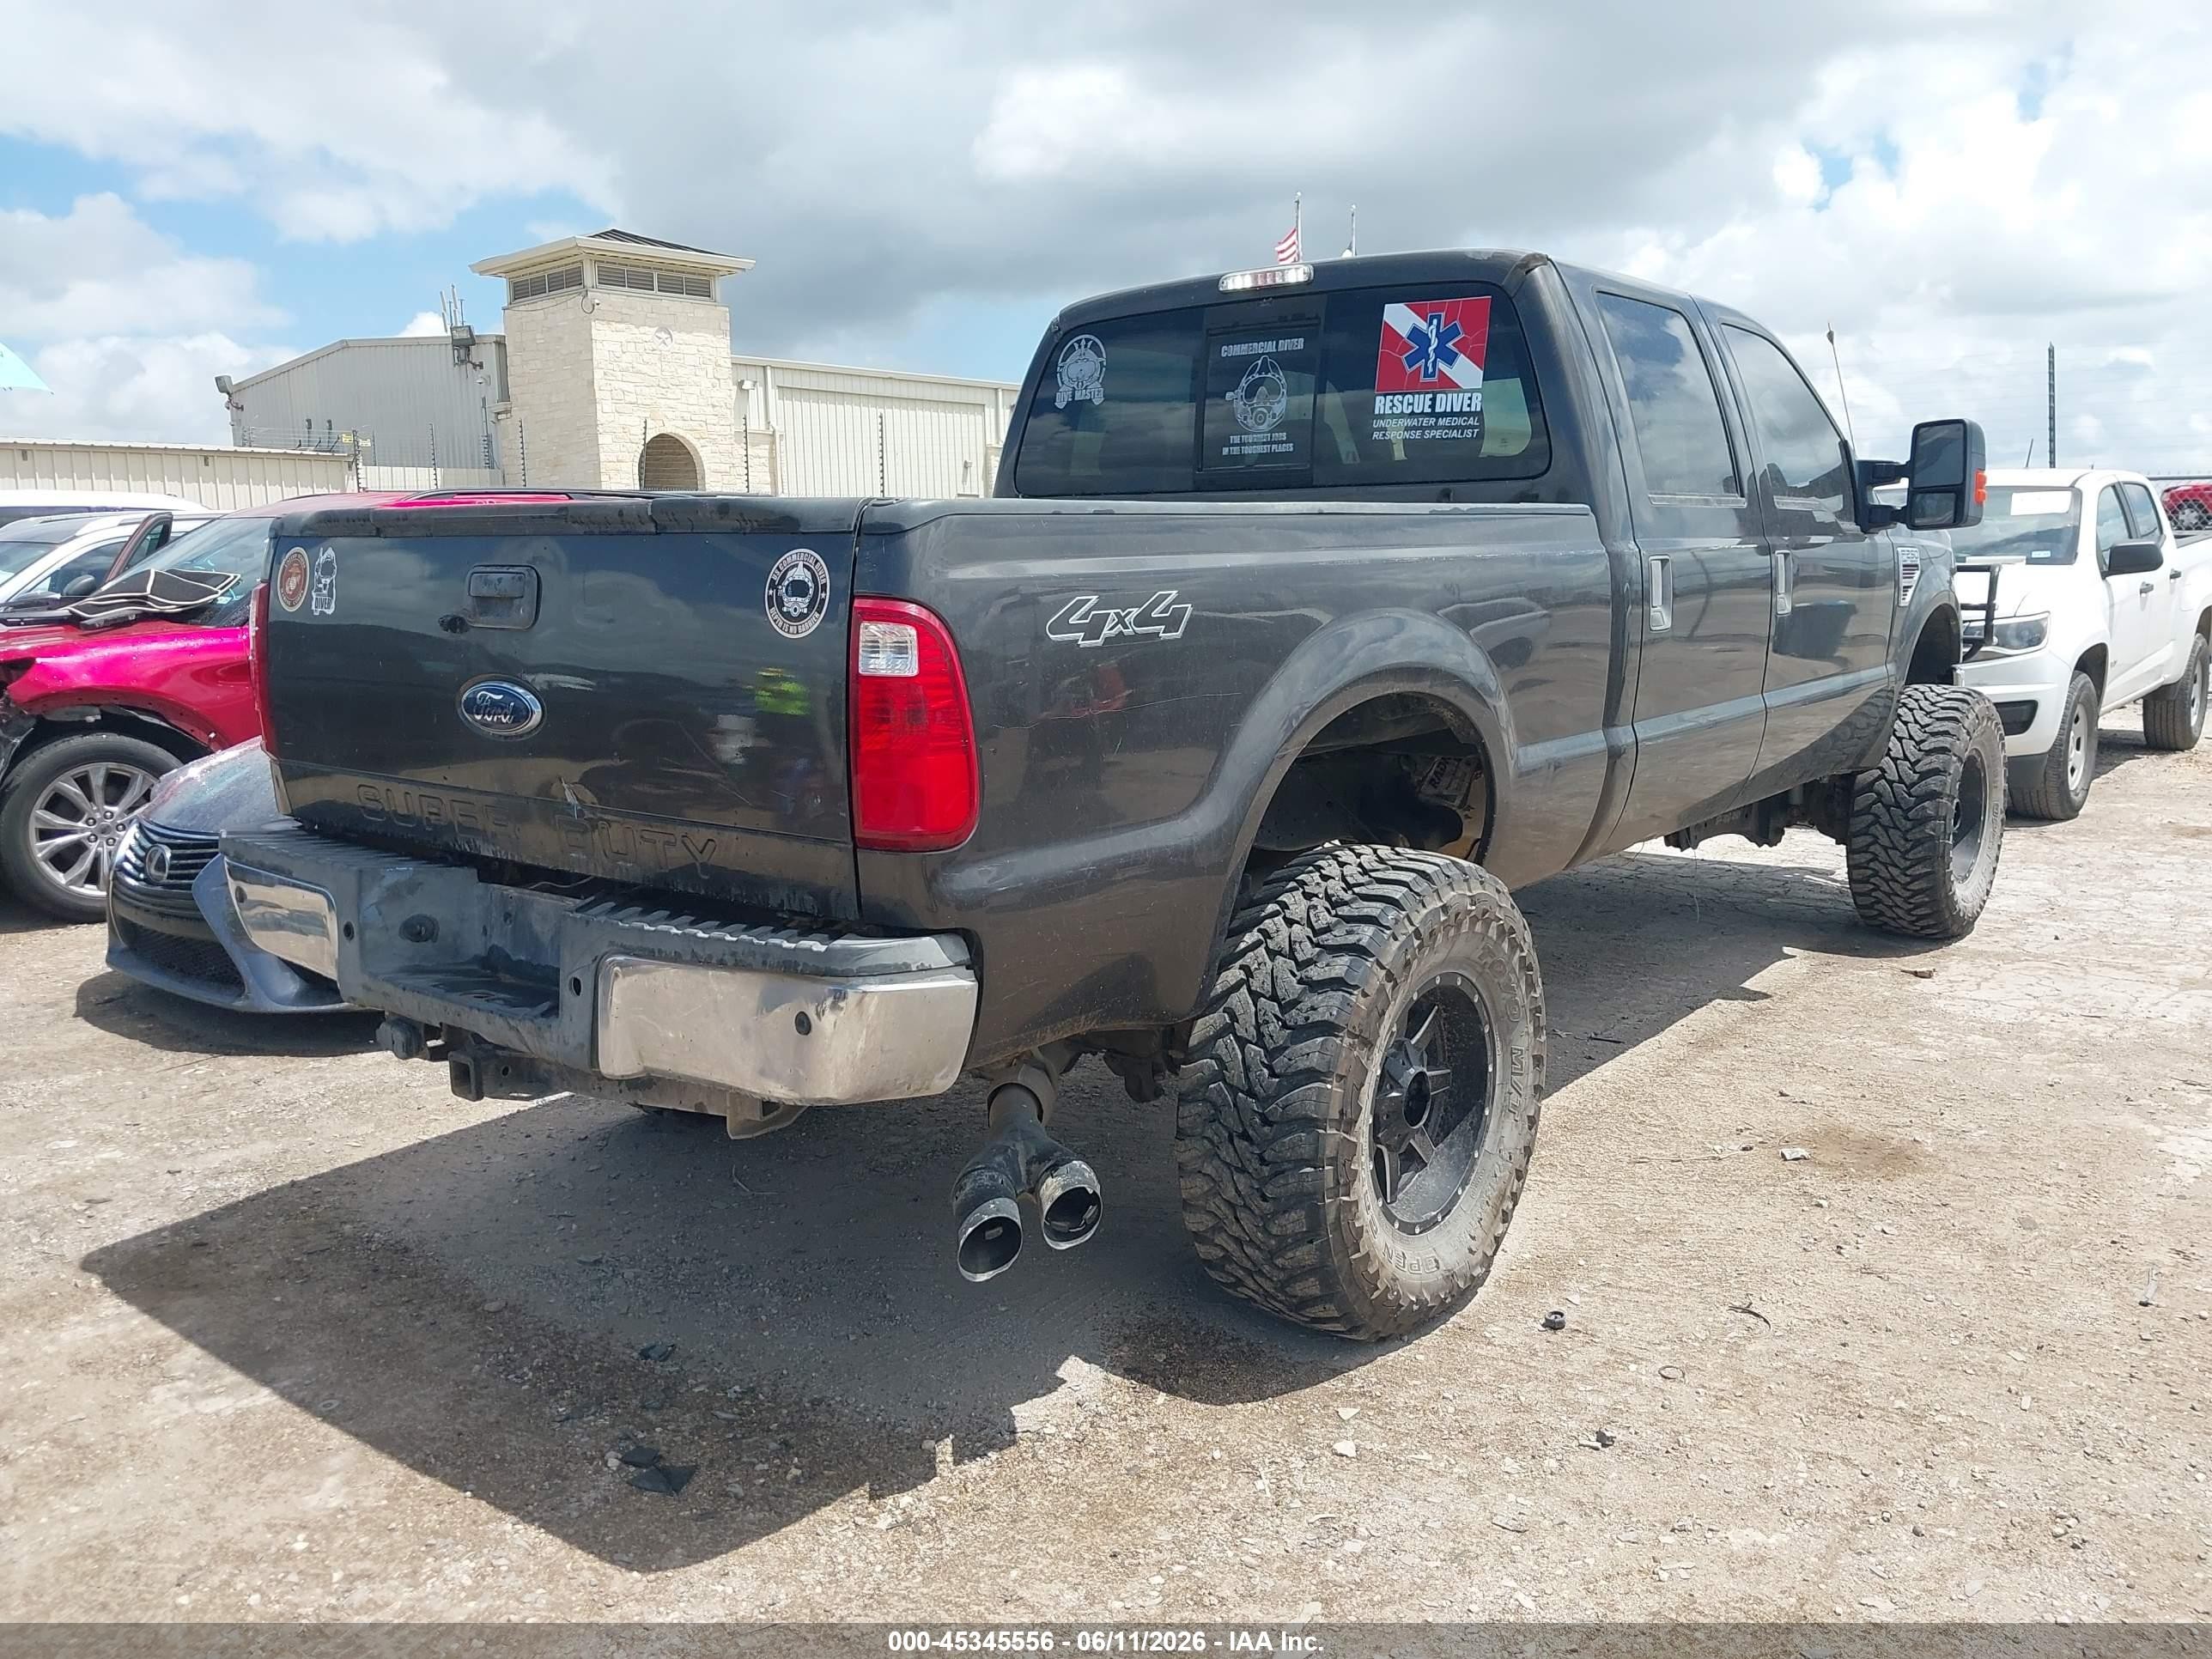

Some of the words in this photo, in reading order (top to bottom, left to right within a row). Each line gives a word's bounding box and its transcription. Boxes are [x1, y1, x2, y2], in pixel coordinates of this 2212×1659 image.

[1221, 341, 1277, 357] COMMERCIAL
[1278, 338, 1304, 350] DIVER
[1056, 391, 1073, 403] DIVE
[1375, 393, 1433, 415] RESCUE
[1435, 392, 1483, 413] DIVER
[1372, 417, 1436, 428] UNDERWATER
[1437, 416, 1480, 426] MEDICAL
[1230, 435, 1240, 444] THE
[1372, 430, 1422, 441] RESPONSE
[1424, 428, 1480, 439] SPECIALIST
[1241, 444, 1271, 454] TOUGHEST
[1271, 443, 1293, 453] PLACES
[772, 570, 781, 580] US
[779, 553, 816, 569] COMMERCIAL
[814, 562, 827, 585] DIVER
[314, 597, 332, 610] DIVER
[1046, 591, 1193, 647] 4x4
[474, 690, 516, 724] Ford
[356, 783, 518, 840] SUPER
[554, 813, 718, 879] DUTY
